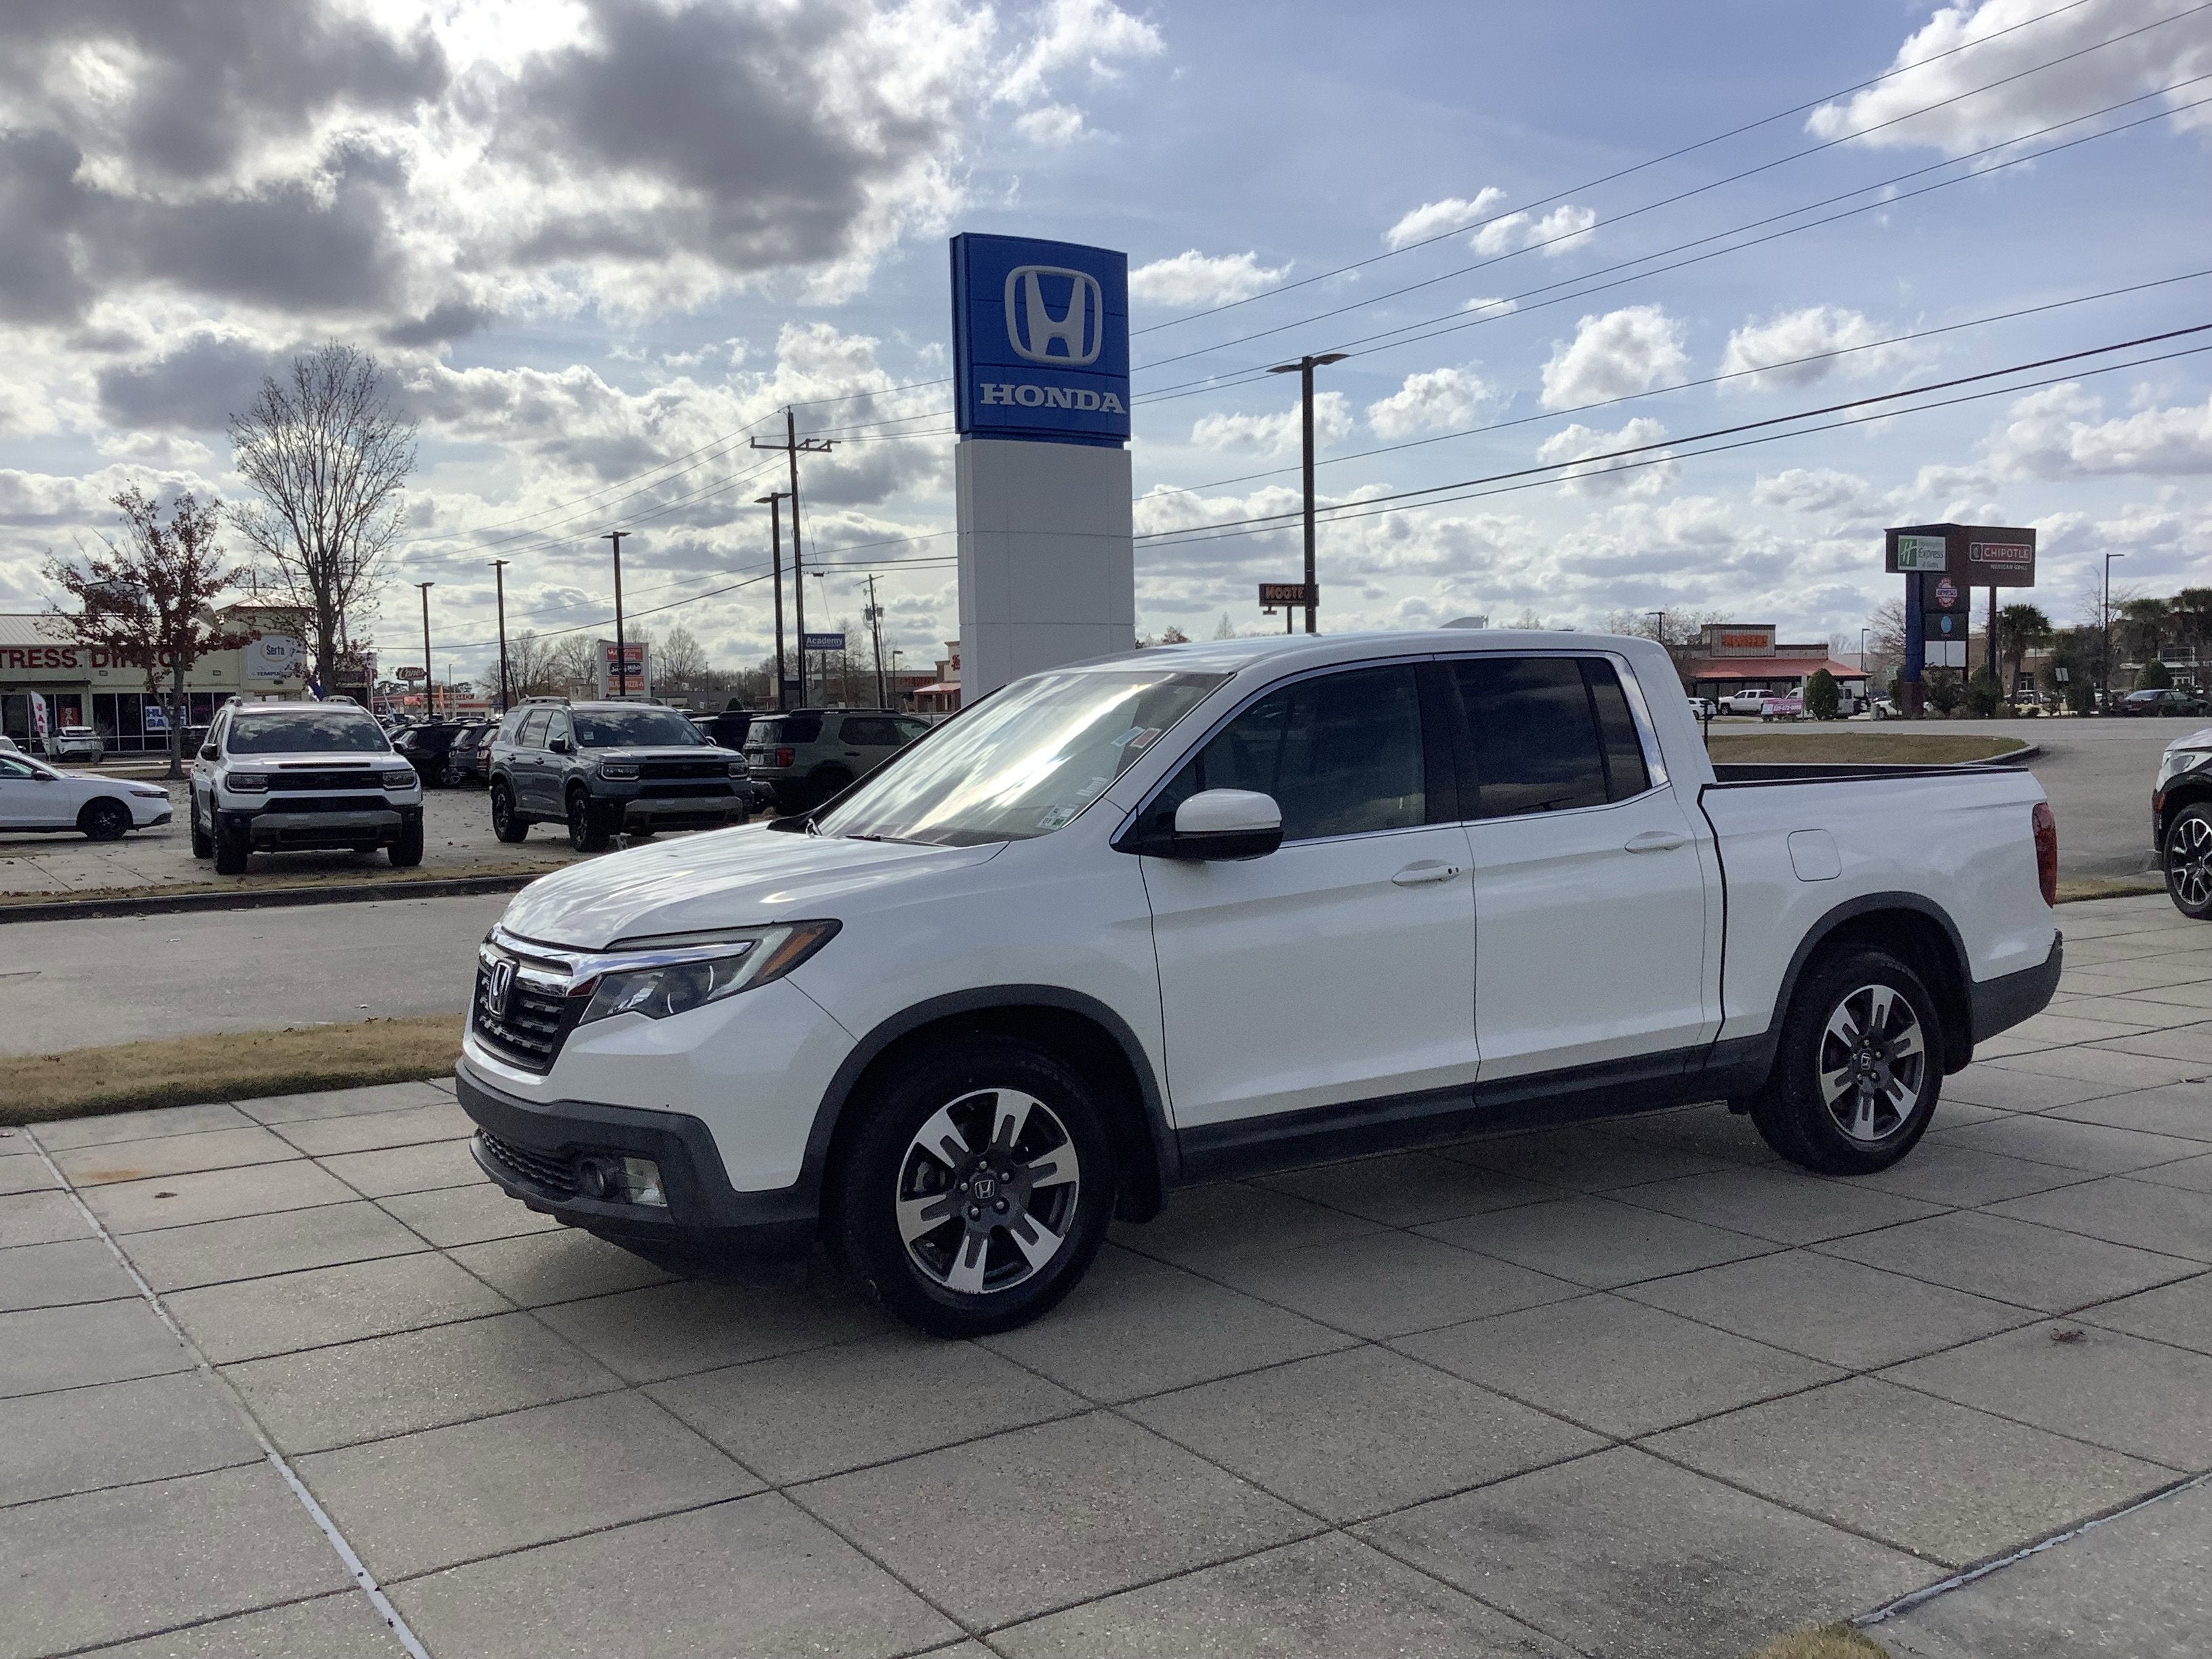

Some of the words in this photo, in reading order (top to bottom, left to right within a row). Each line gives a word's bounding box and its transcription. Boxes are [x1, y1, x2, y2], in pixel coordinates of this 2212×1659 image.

[980, 383, 1127, 415] HONDA
[1919, 548, 1944, 560] Express
[1984, 548, 2028, 558] CHIPOTLE
[806, 637, 842, 645] Academy
[266, 644, 285, 655] Serta
